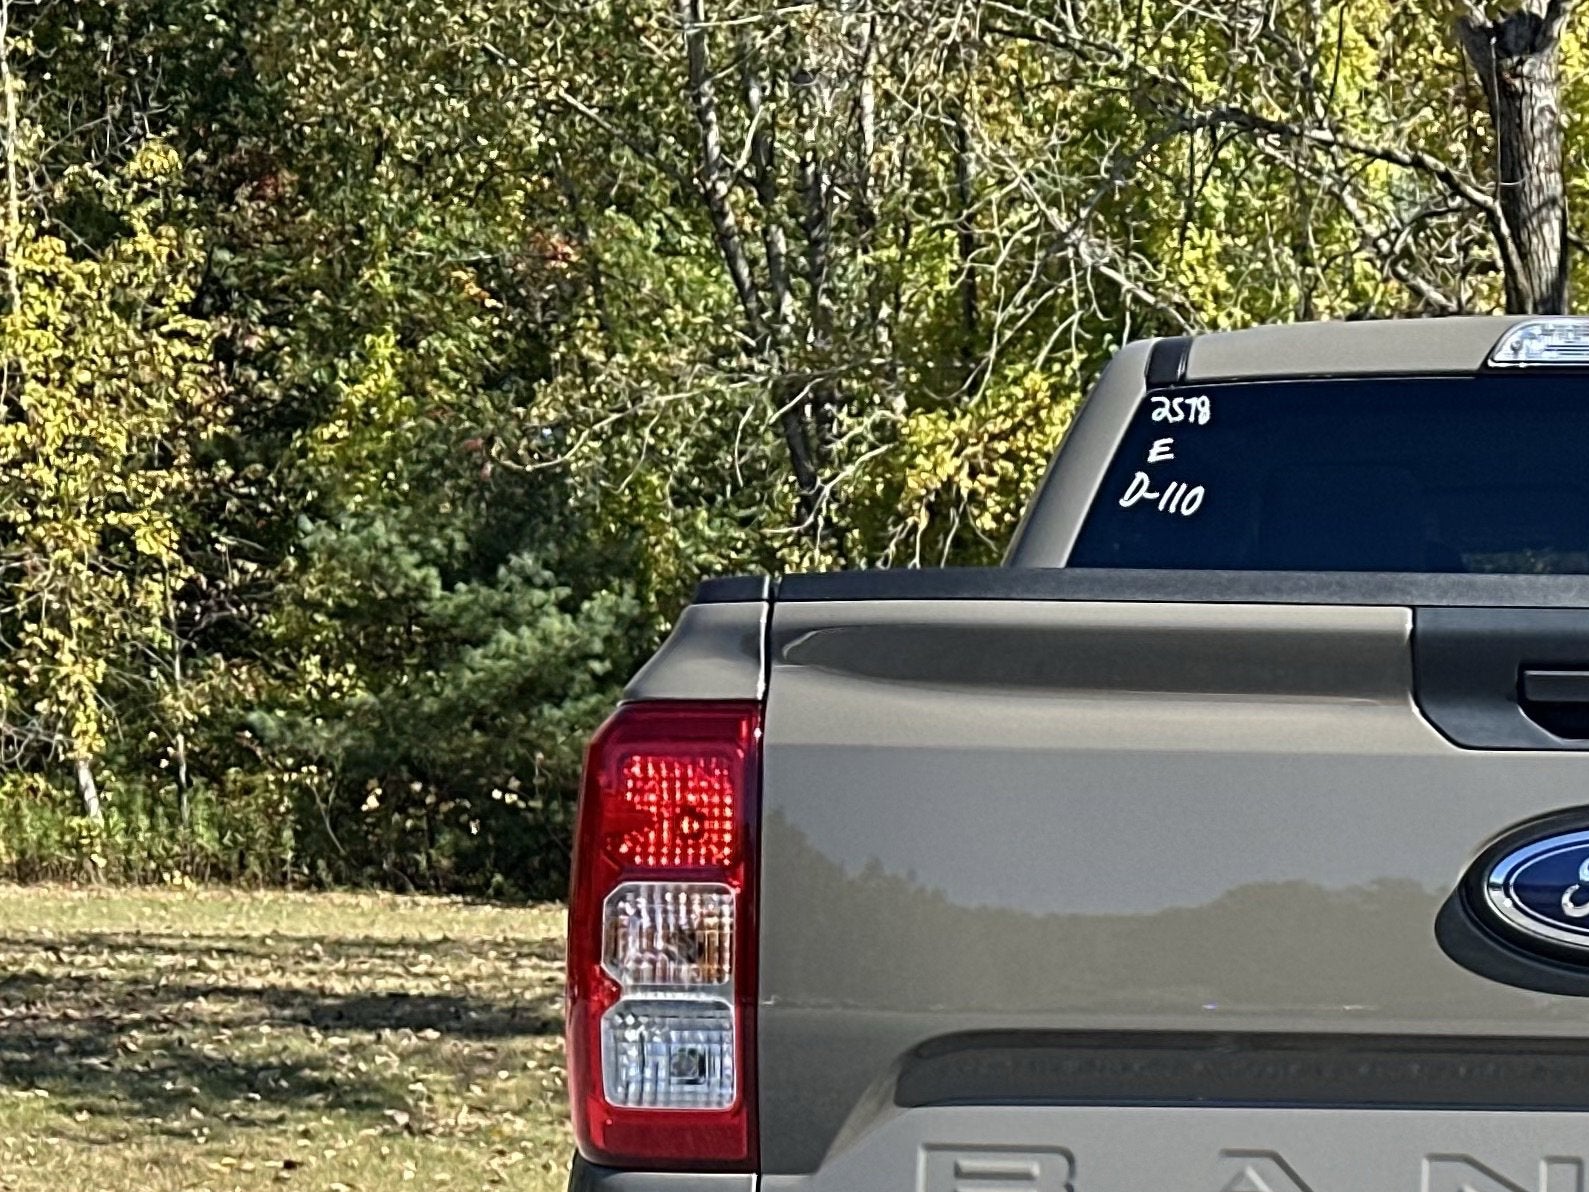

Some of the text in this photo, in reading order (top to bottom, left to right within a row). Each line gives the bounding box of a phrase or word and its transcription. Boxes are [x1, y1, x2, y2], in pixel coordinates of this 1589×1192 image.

[1151, 395, 1211, 425] 2578
[1147, 437, 1175, 463] E
[1118, 471, 1205, 516] D-110
